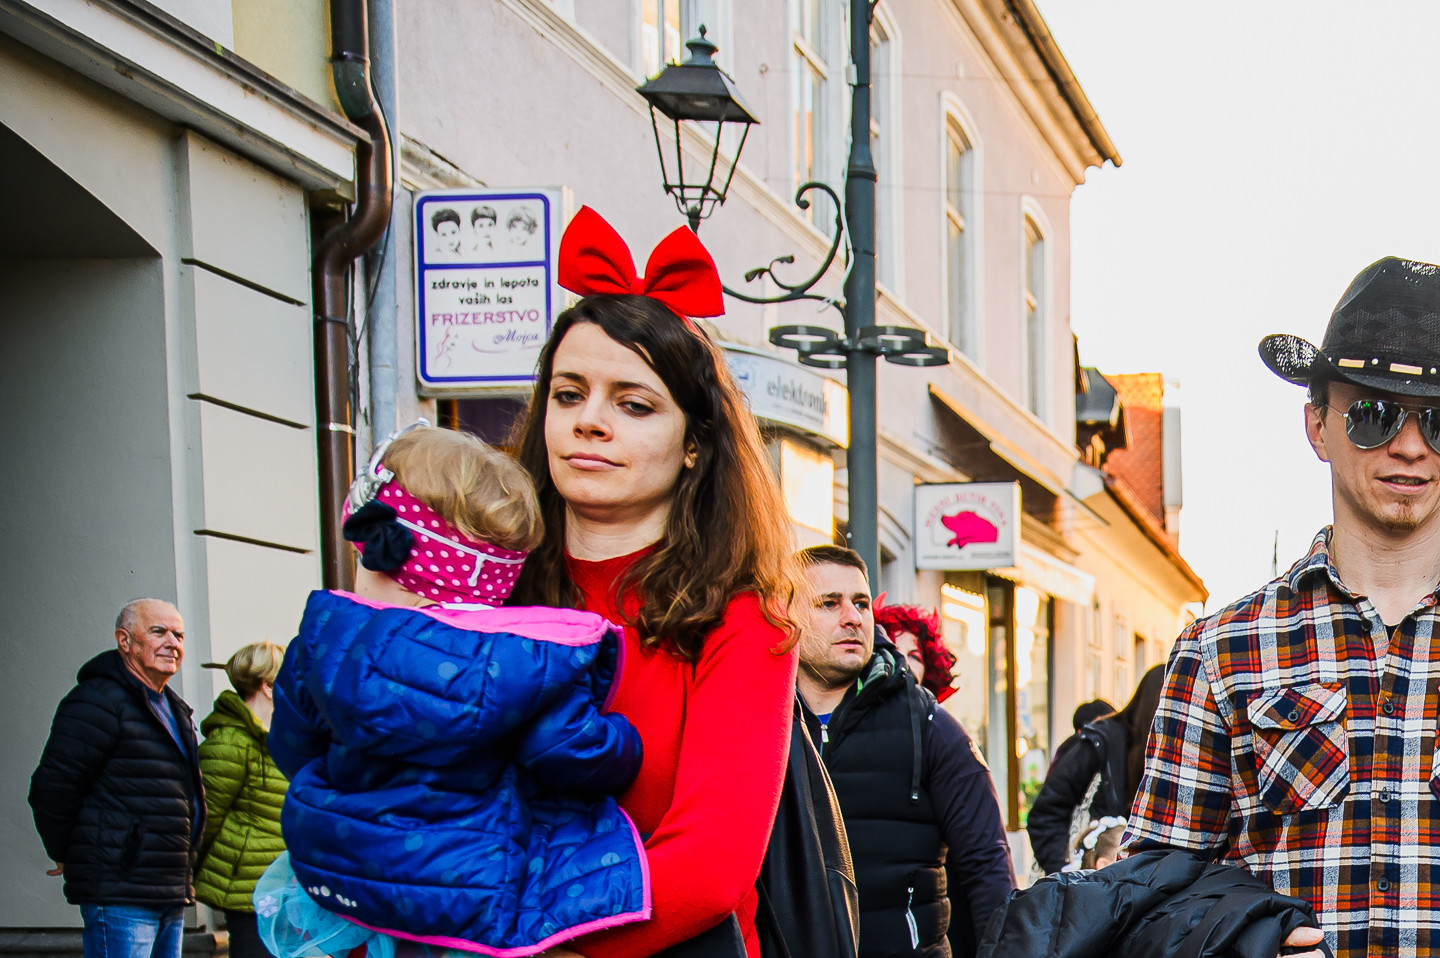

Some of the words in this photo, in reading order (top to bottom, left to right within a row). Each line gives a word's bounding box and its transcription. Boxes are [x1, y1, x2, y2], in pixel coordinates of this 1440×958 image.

[431, 277, 478, 290] zdravje
[484, 277, 495, 289] in
[500, 276, 539, 290] lepota
[458, 292, 491, 305] vaših
[496, 293, 513, 304] las
[431, 309, 540, 326] FRIZERSTVO
